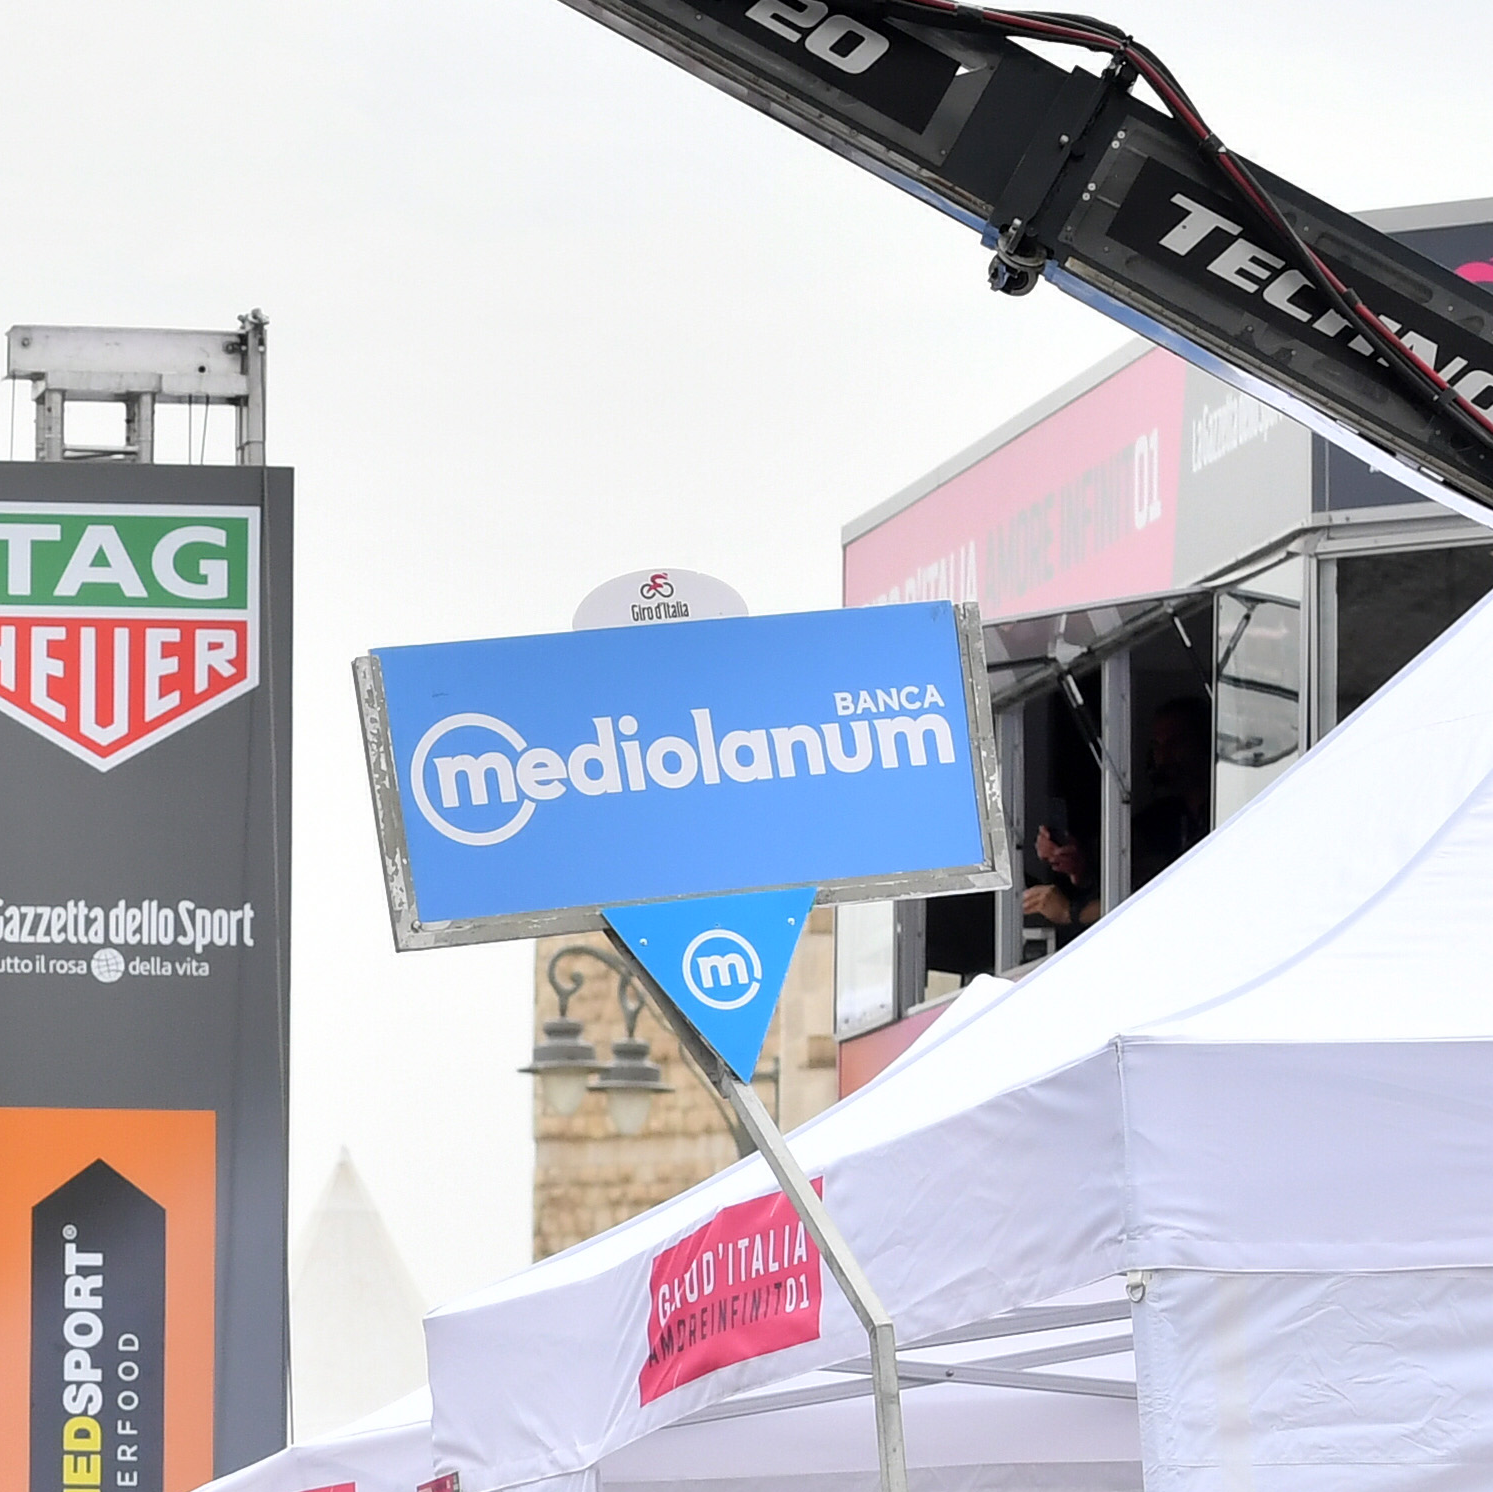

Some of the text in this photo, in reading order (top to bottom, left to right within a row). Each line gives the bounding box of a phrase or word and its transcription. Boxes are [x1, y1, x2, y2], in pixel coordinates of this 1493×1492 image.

[745, 0, 890, 74] 20
[630, 603, 653, 623] Giro
[833, 684, 945, 717] BANCA
[434, 707, 956, 808] mediolanum
[109, 898, 175, 946] dello
[176, 899, 255, 954] Sport
[35, 954, 47, 975] il
[49, 958, 87, 976] rosa
[128, 954, 172, 977] della
[175, 955, 210, 978] vita
